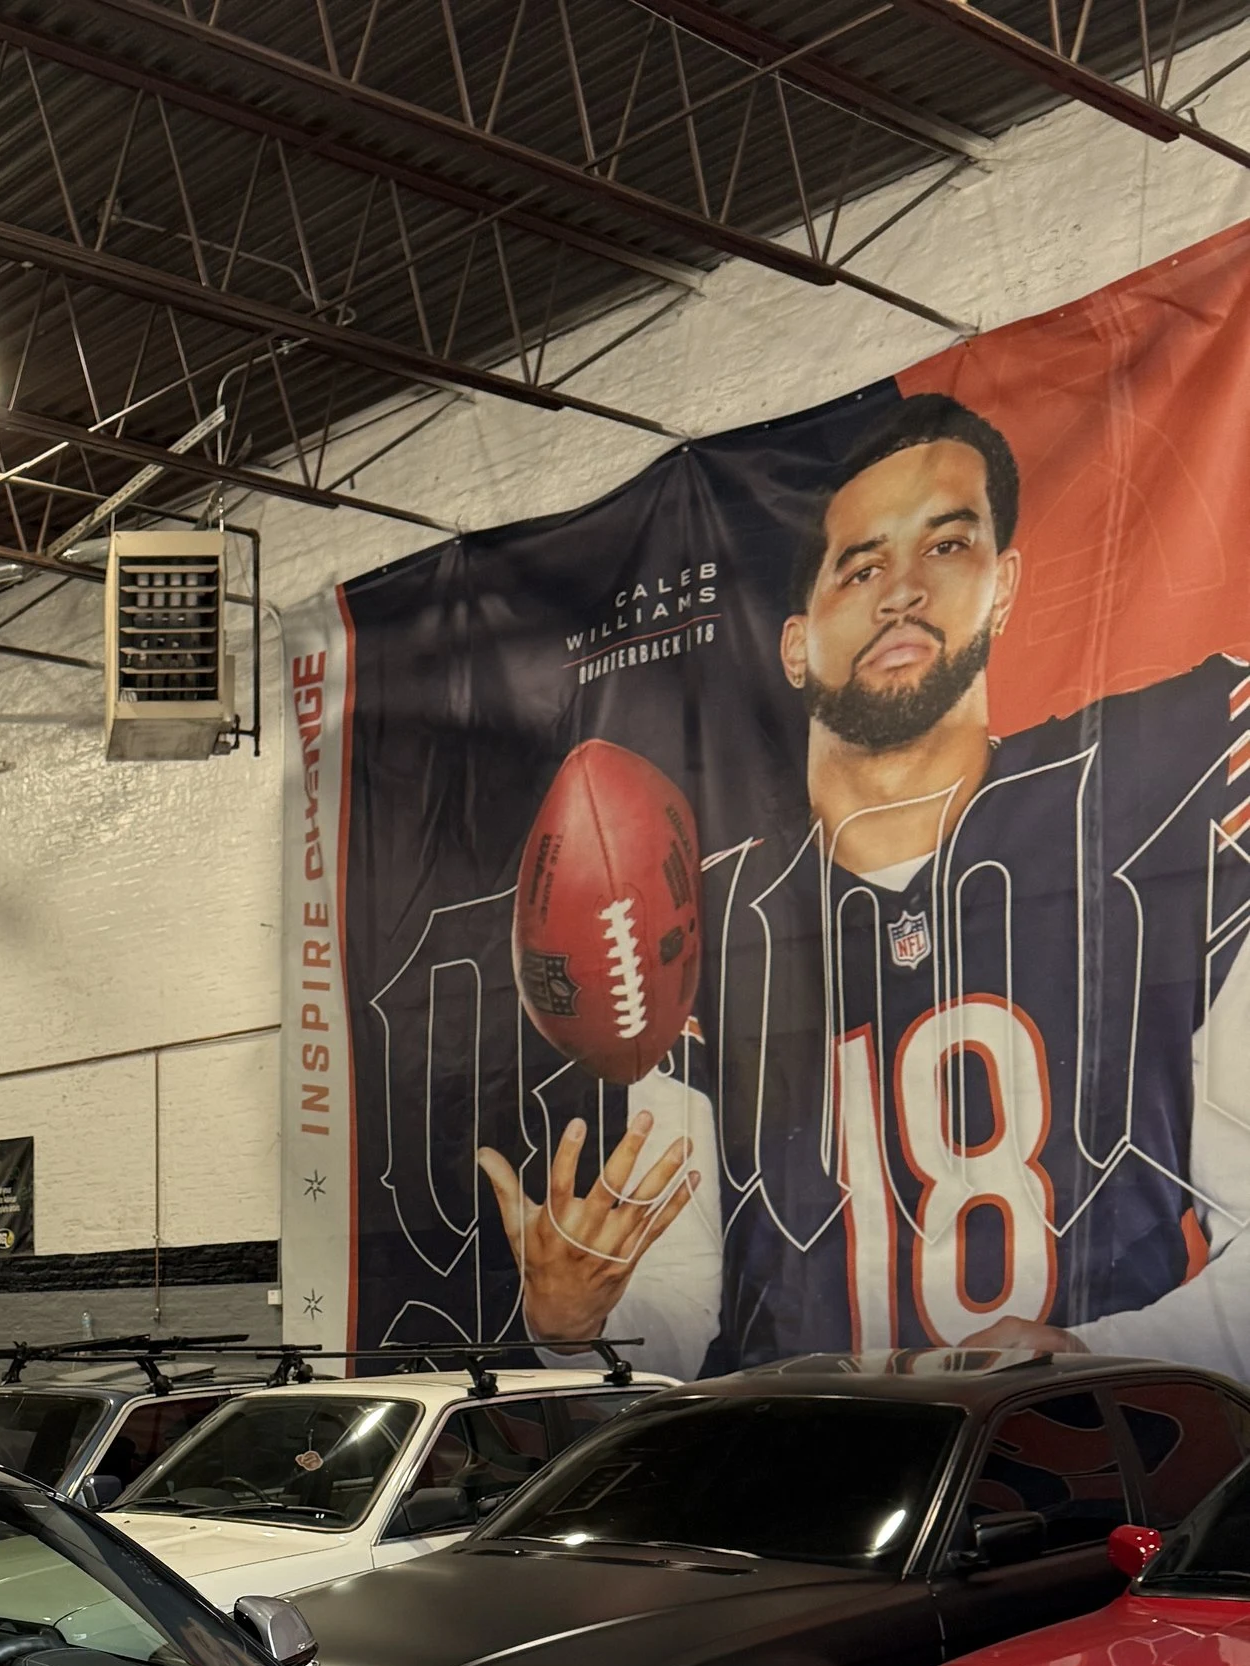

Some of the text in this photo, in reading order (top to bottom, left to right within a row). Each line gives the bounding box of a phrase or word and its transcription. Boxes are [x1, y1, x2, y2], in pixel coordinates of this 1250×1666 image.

[615, 562, 717, 608] CALEB
[566, 587, 716, 651] WILLIAMS
[578, 623, 715, 685] QUARTERBACK 18
[897, 933, 925, 957] NFL
[301, 901, 331, 1136] INSPIRE
[831, 992, 1058, 1353] 18
